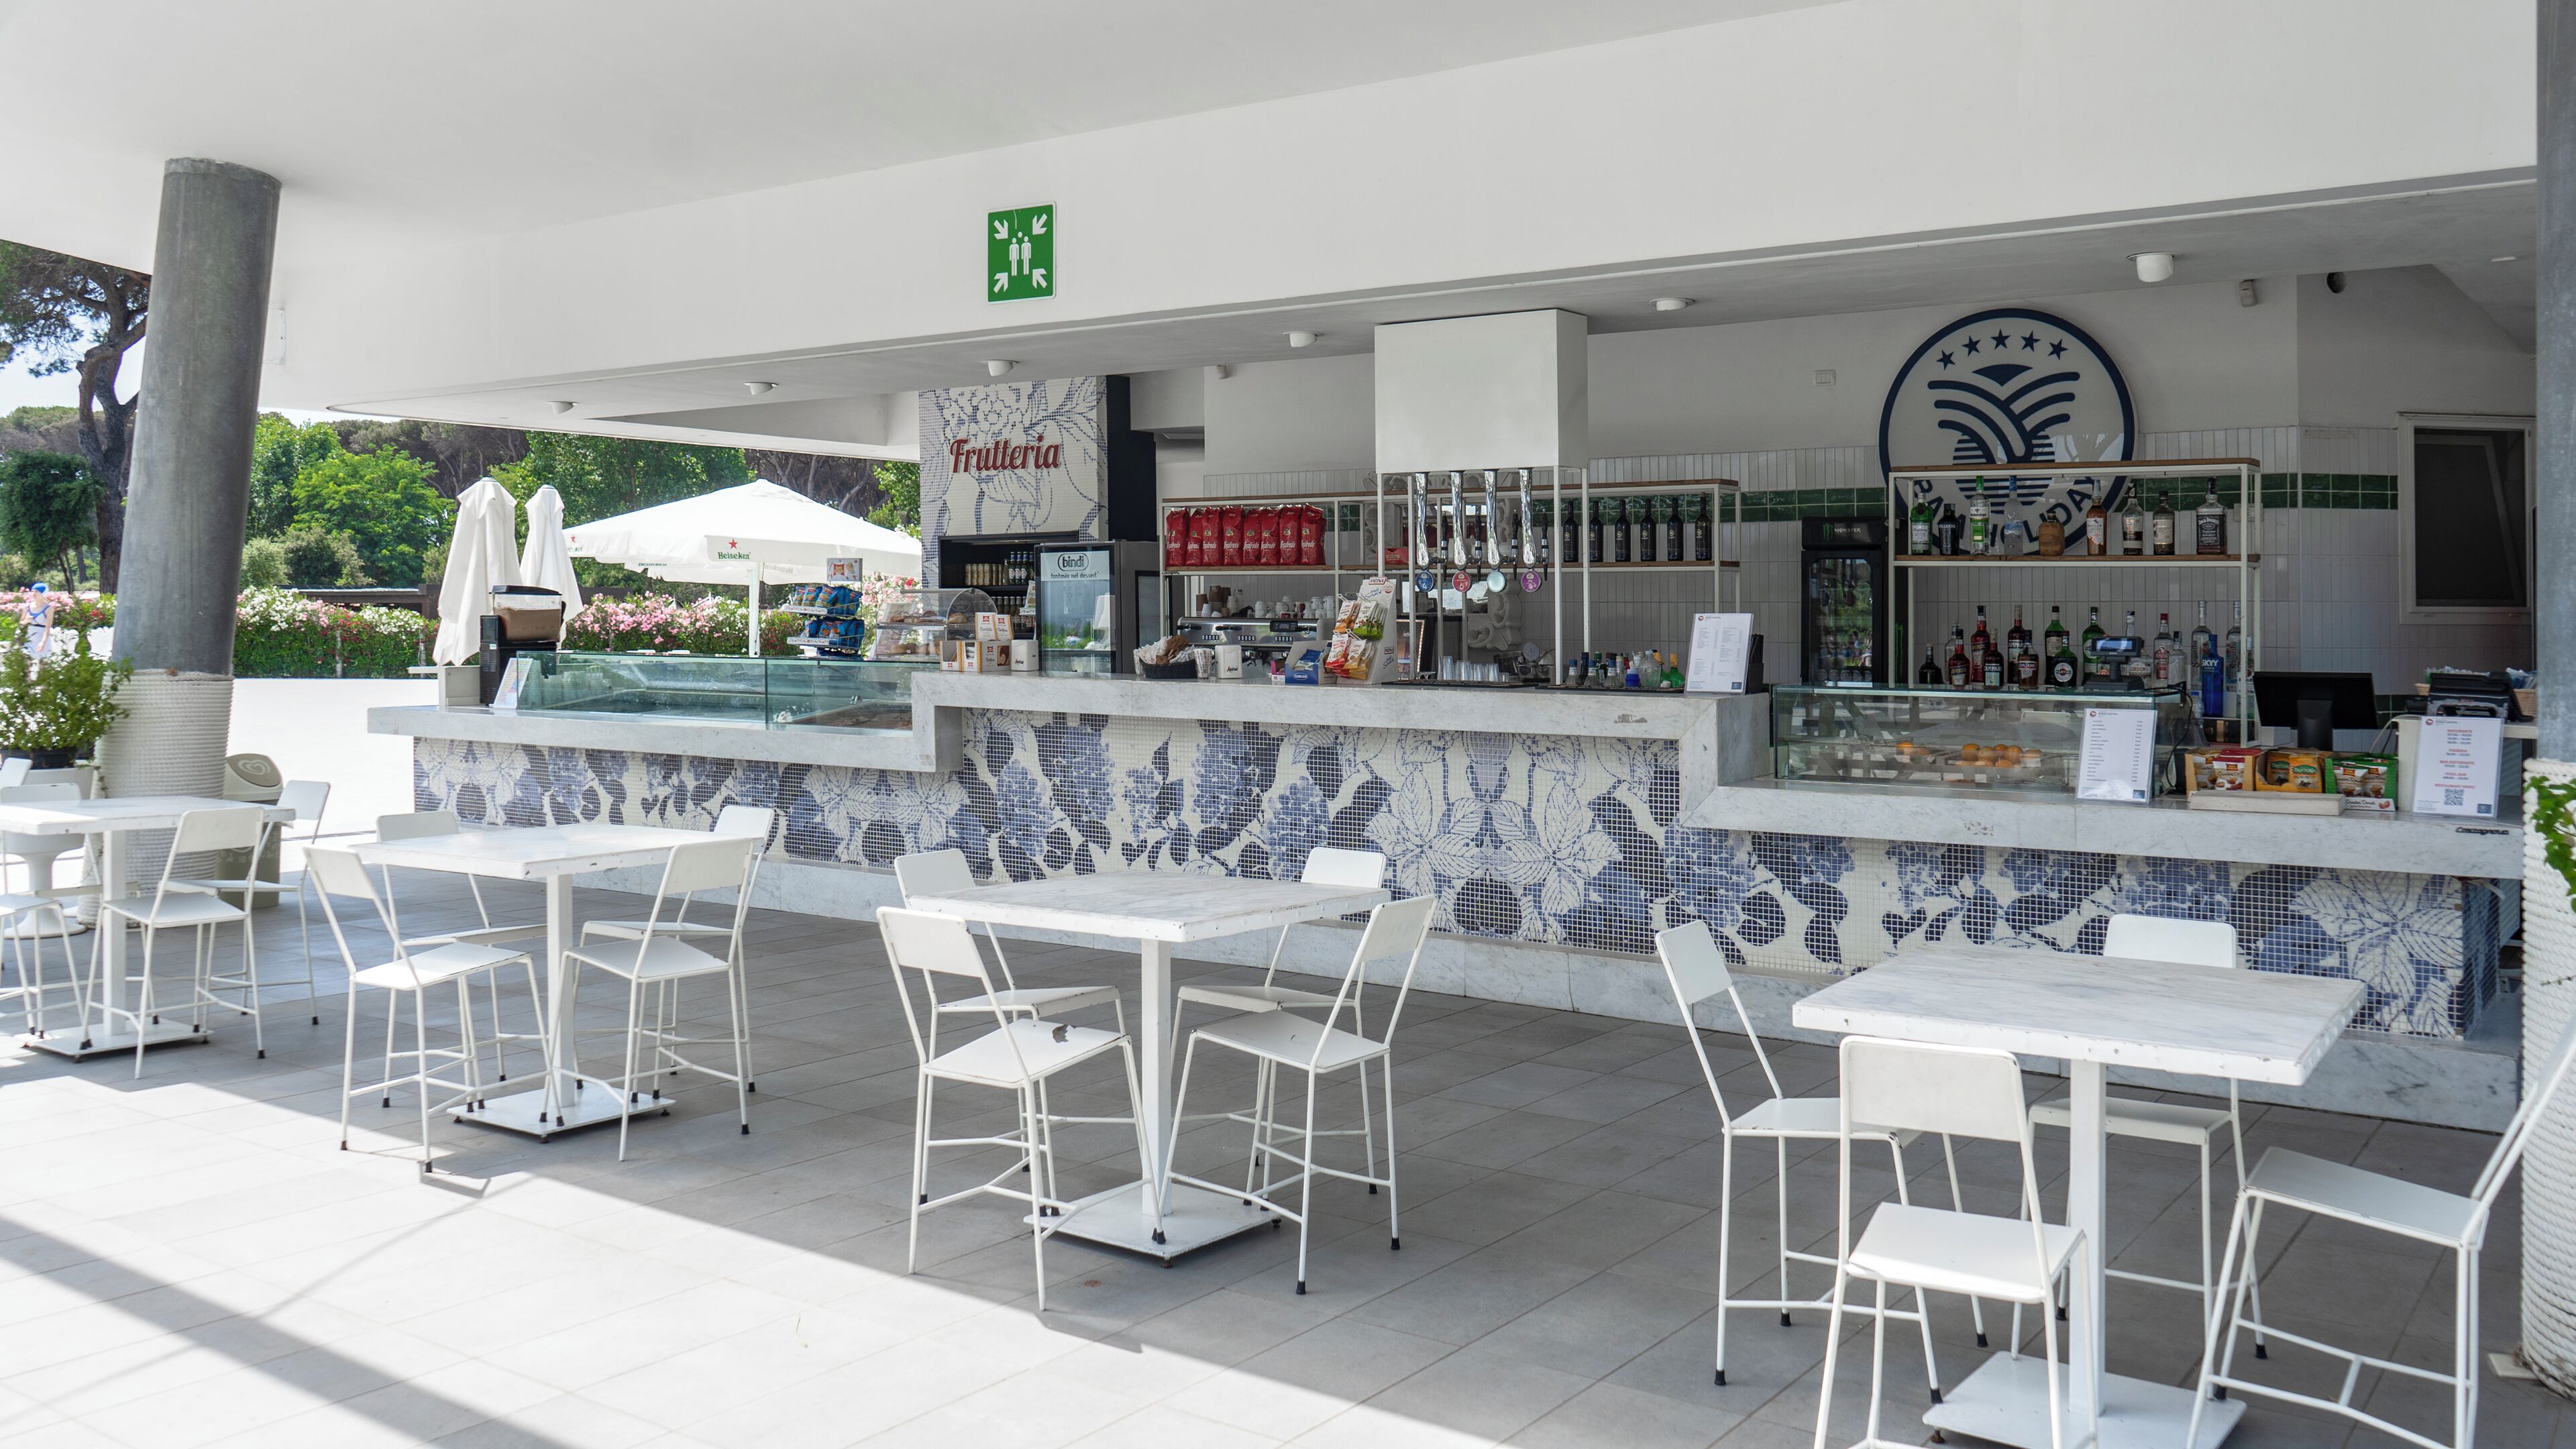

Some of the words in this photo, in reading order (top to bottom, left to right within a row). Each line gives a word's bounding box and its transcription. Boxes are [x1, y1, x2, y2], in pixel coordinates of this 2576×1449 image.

[950, 435, 1060, 474] Frutteria
[718, 551, 750, 559] Heineken
[1063, 555, 1085, 568] bindi
